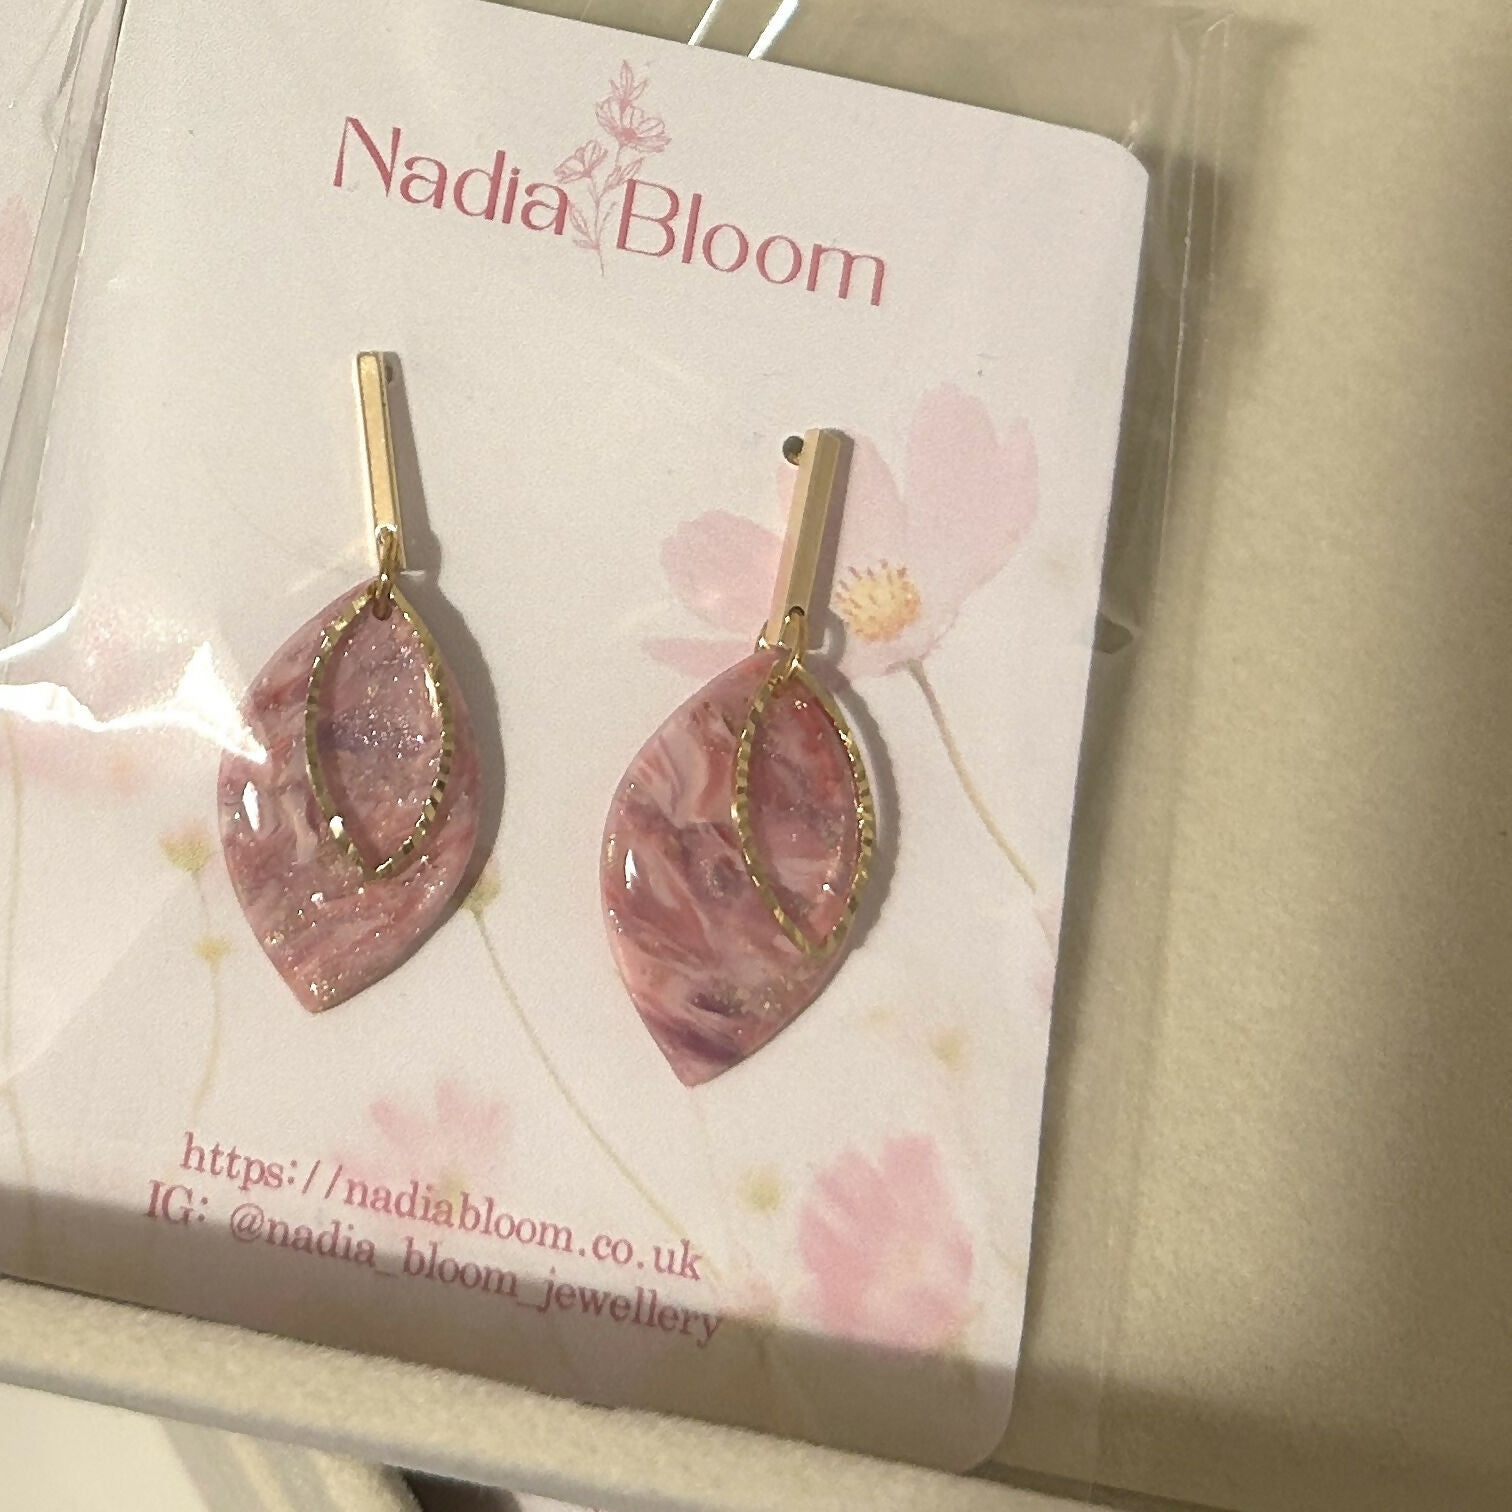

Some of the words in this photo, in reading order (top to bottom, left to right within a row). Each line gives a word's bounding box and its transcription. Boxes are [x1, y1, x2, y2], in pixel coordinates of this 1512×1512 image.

[333, 116, 570, 235] Nadia
[616, 178, 886, 306] Bloom
[144, 1180, 210, 1226] IG:
[230, 1202, 723, 1346] @nadia_bloom_jewellery
[180, 1132, 702, 1280] https://nadiabloom.co.uk
